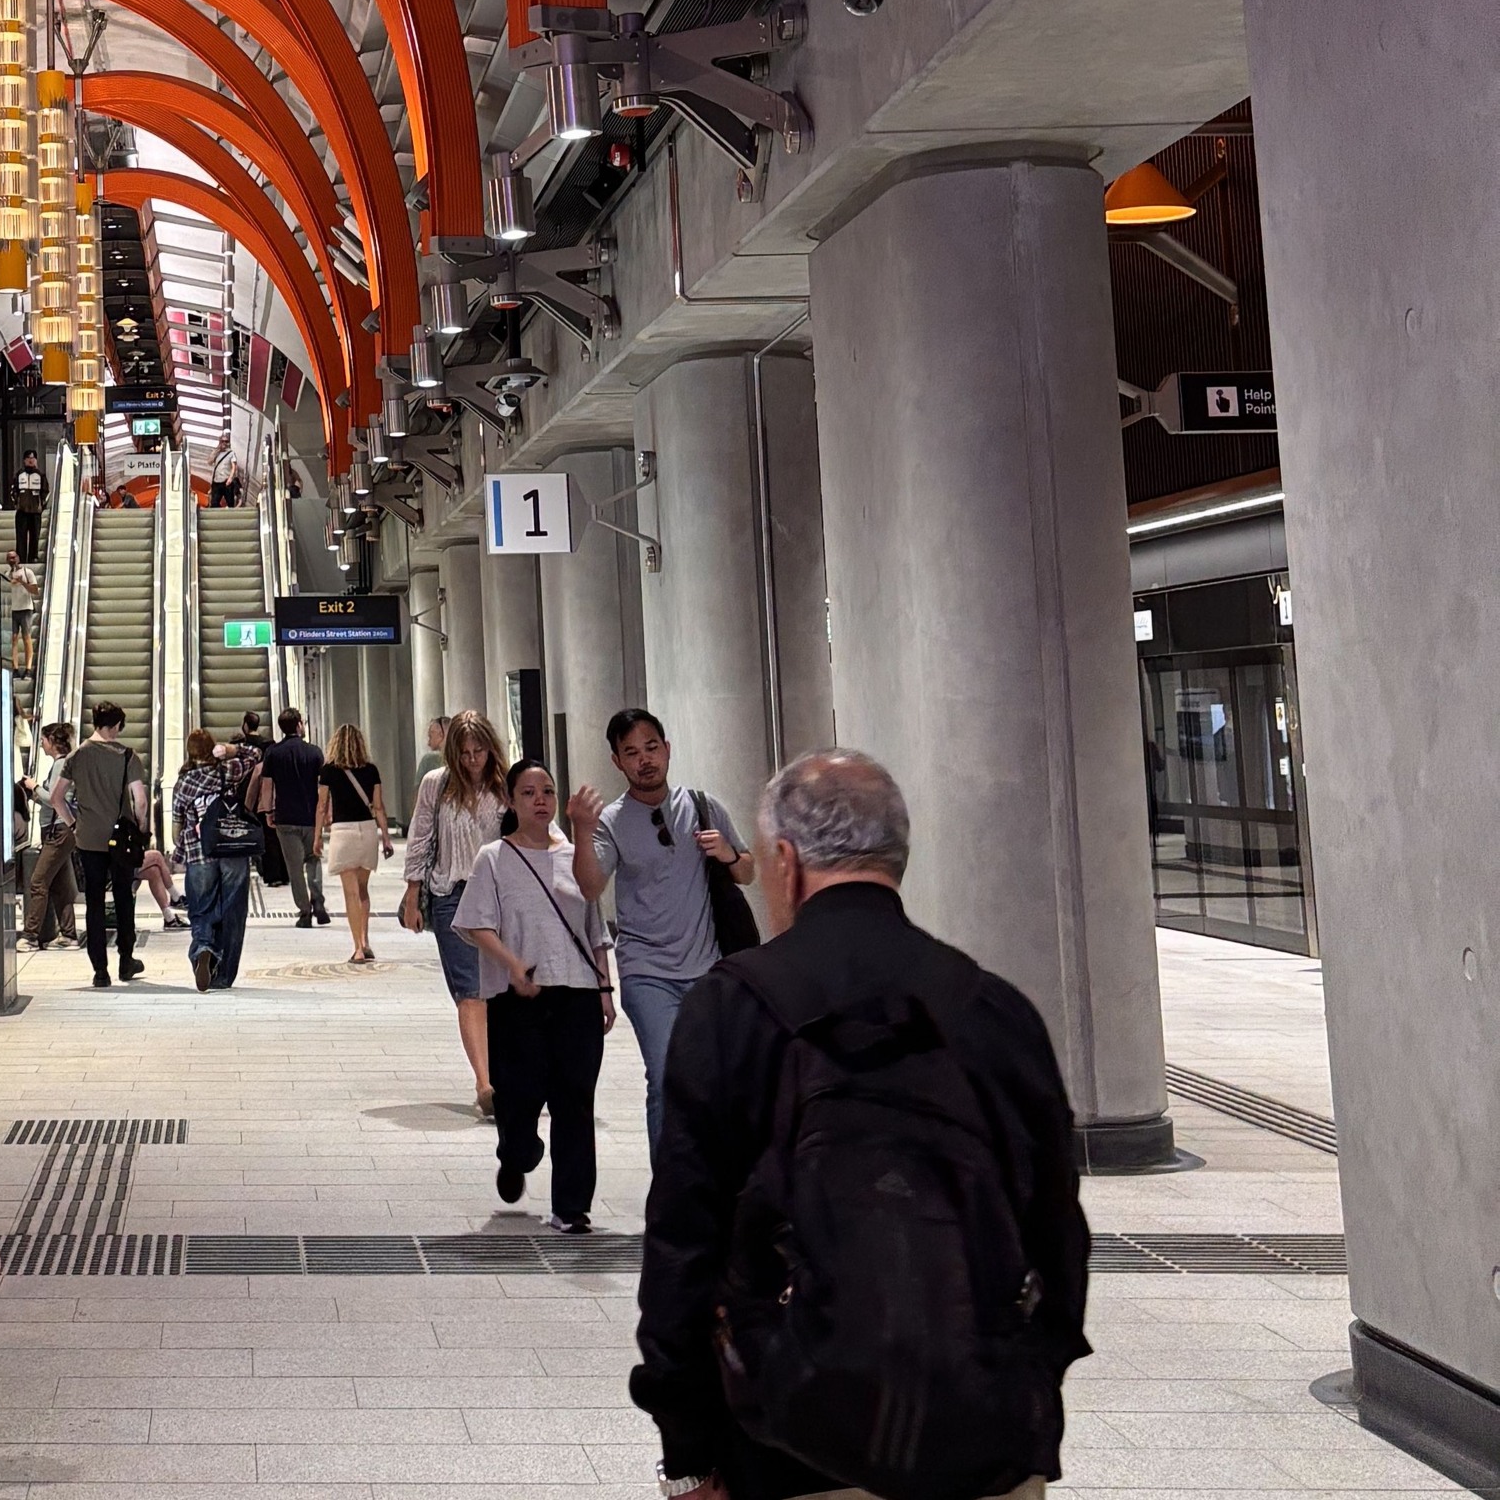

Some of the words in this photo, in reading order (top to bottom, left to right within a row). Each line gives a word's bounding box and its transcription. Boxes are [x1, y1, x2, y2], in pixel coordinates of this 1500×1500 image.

[145, 391, 159, 399] Exit
[160, 391, 165, 399] 2
[1244, 388, 1272, 402] Help
[1245, 403, 1276, 414] Point
[137, 461, 160, 469] Platfo
[523, 489, 548, 537] 1
[319, 601, 343, 613] Exit
[346, 601, 355, 613] 2
[299, 630, 325, 638] Flinders
[326, 630, 347, 638] Street
[348, 629, 371, 637] Station
